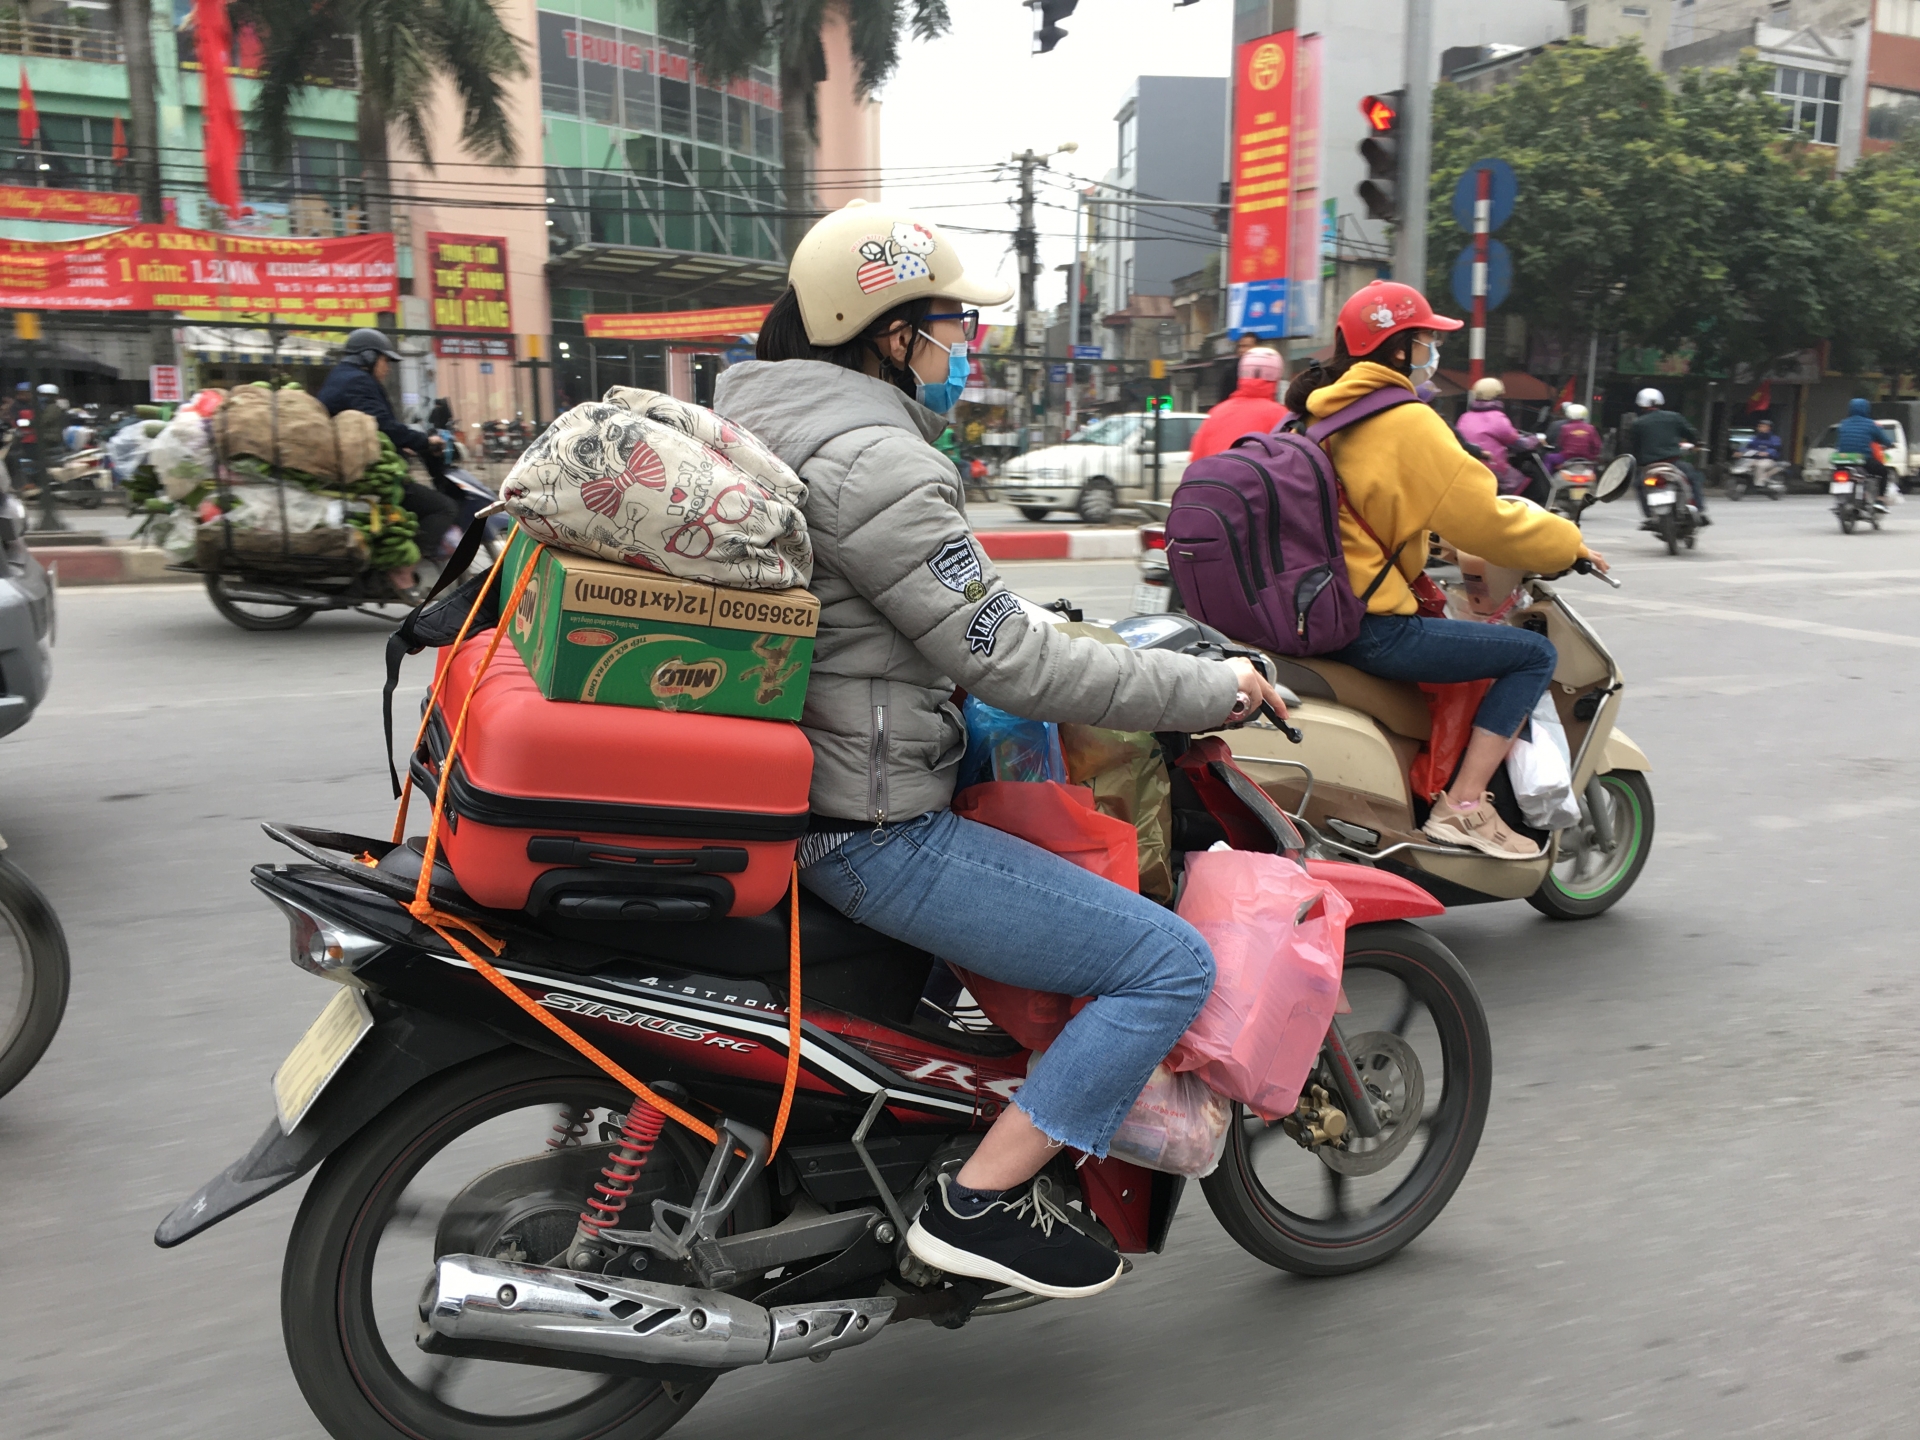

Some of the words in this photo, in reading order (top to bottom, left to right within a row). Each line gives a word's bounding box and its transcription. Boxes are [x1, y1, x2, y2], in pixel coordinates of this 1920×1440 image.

[562, 29, 643, 72] TRUNG
[118, 257, 134, 282] 1
[938, 548, 969, 571] glamorous
[942, 564, 961, 580] tough
[575, 578, 709, 615] 12(4x180ml)
[719, 599, 814, 628] 12365030
[975, 594, 1015, 636] AMAZING
[595, 666, 604, 677] RA
[658, 669, 717, 688] MILO
[535, 992, 718, 1041] SIRIUS
[704, 1037, 758, 1052] RC
